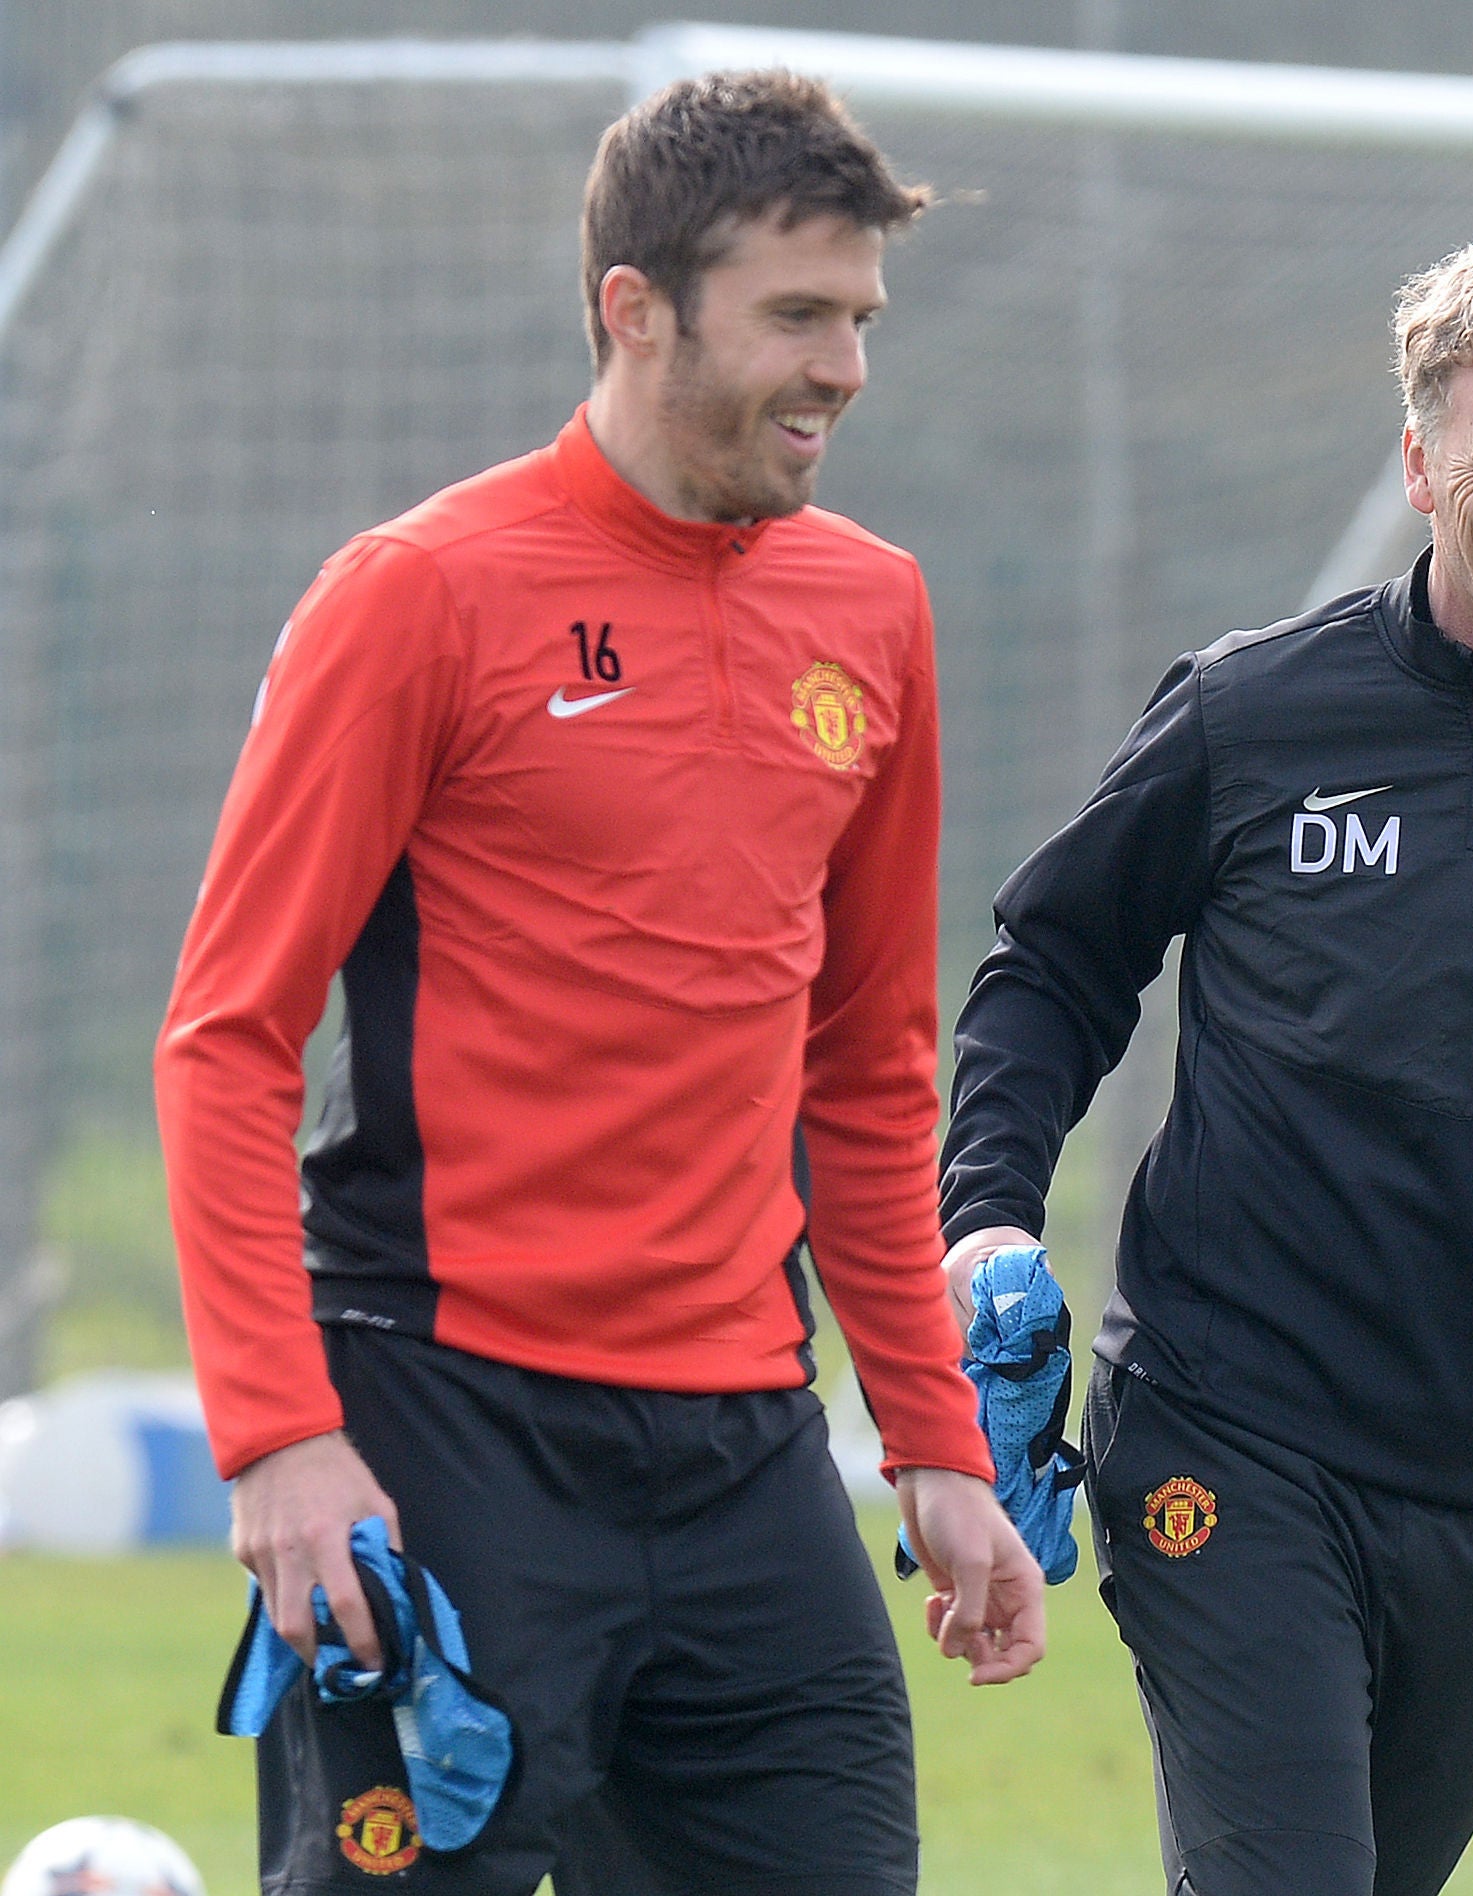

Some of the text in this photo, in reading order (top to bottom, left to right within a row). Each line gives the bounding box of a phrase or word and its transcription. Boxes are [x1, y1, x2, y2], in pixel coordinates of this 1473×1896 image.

[570, 620, 622, 682] 16
[1290, 813, 1401, 875] DM
[1150, 1482, 1210, 1510] MANCHESTER
[1159, 1537, 1199, 1552] UNITED
